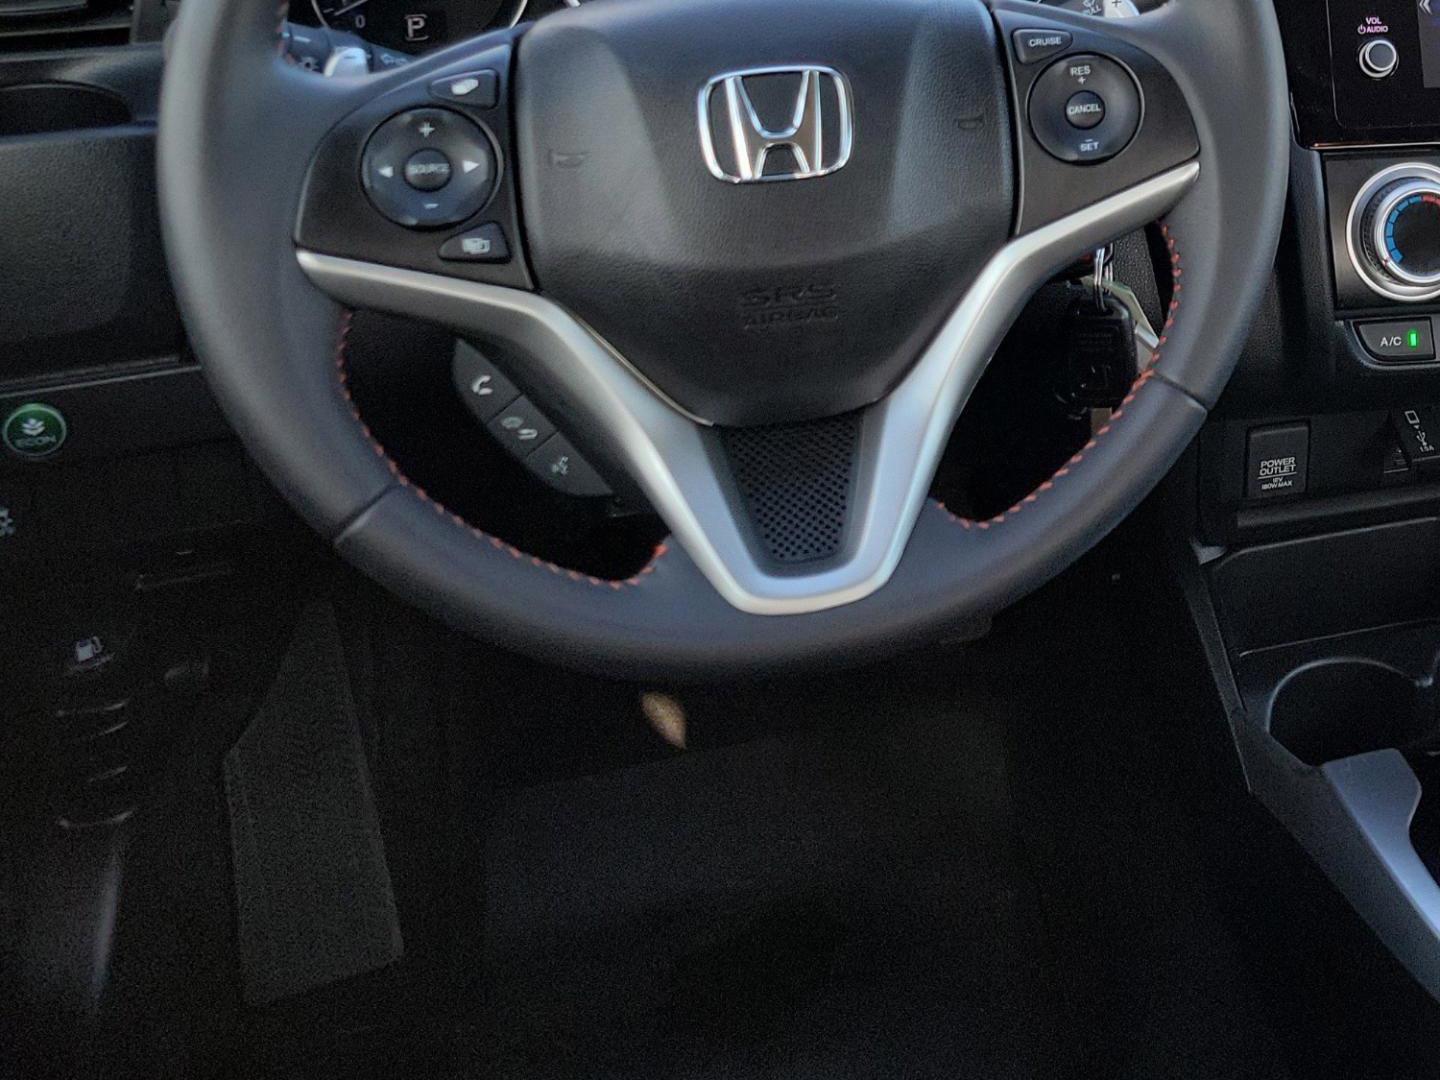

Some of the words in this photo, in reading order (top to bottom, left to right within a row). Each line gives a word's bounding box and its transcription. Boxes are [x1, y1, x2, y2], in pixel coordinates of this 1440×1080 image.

[355, 15, 366, 28] 0
[1365, 16, 1382, 24] VOL
[406, 17, 426, 38] P
[1366, 25, 1389, 33] AUDIO
[1028, 36, 1062, 48] CRUISE
[1070, 65, 1091, 76] RES
[1067, 103, 1101, 115] CANCEL
[1080, 141, 1099, 152] SET
[1380, 336, 1403, 348] A/C
[1260, 456, 1296, 469] POWER
[1259, 464, 1296, 476] OUTLET
[1278, 480, 1292, 488] MAX
